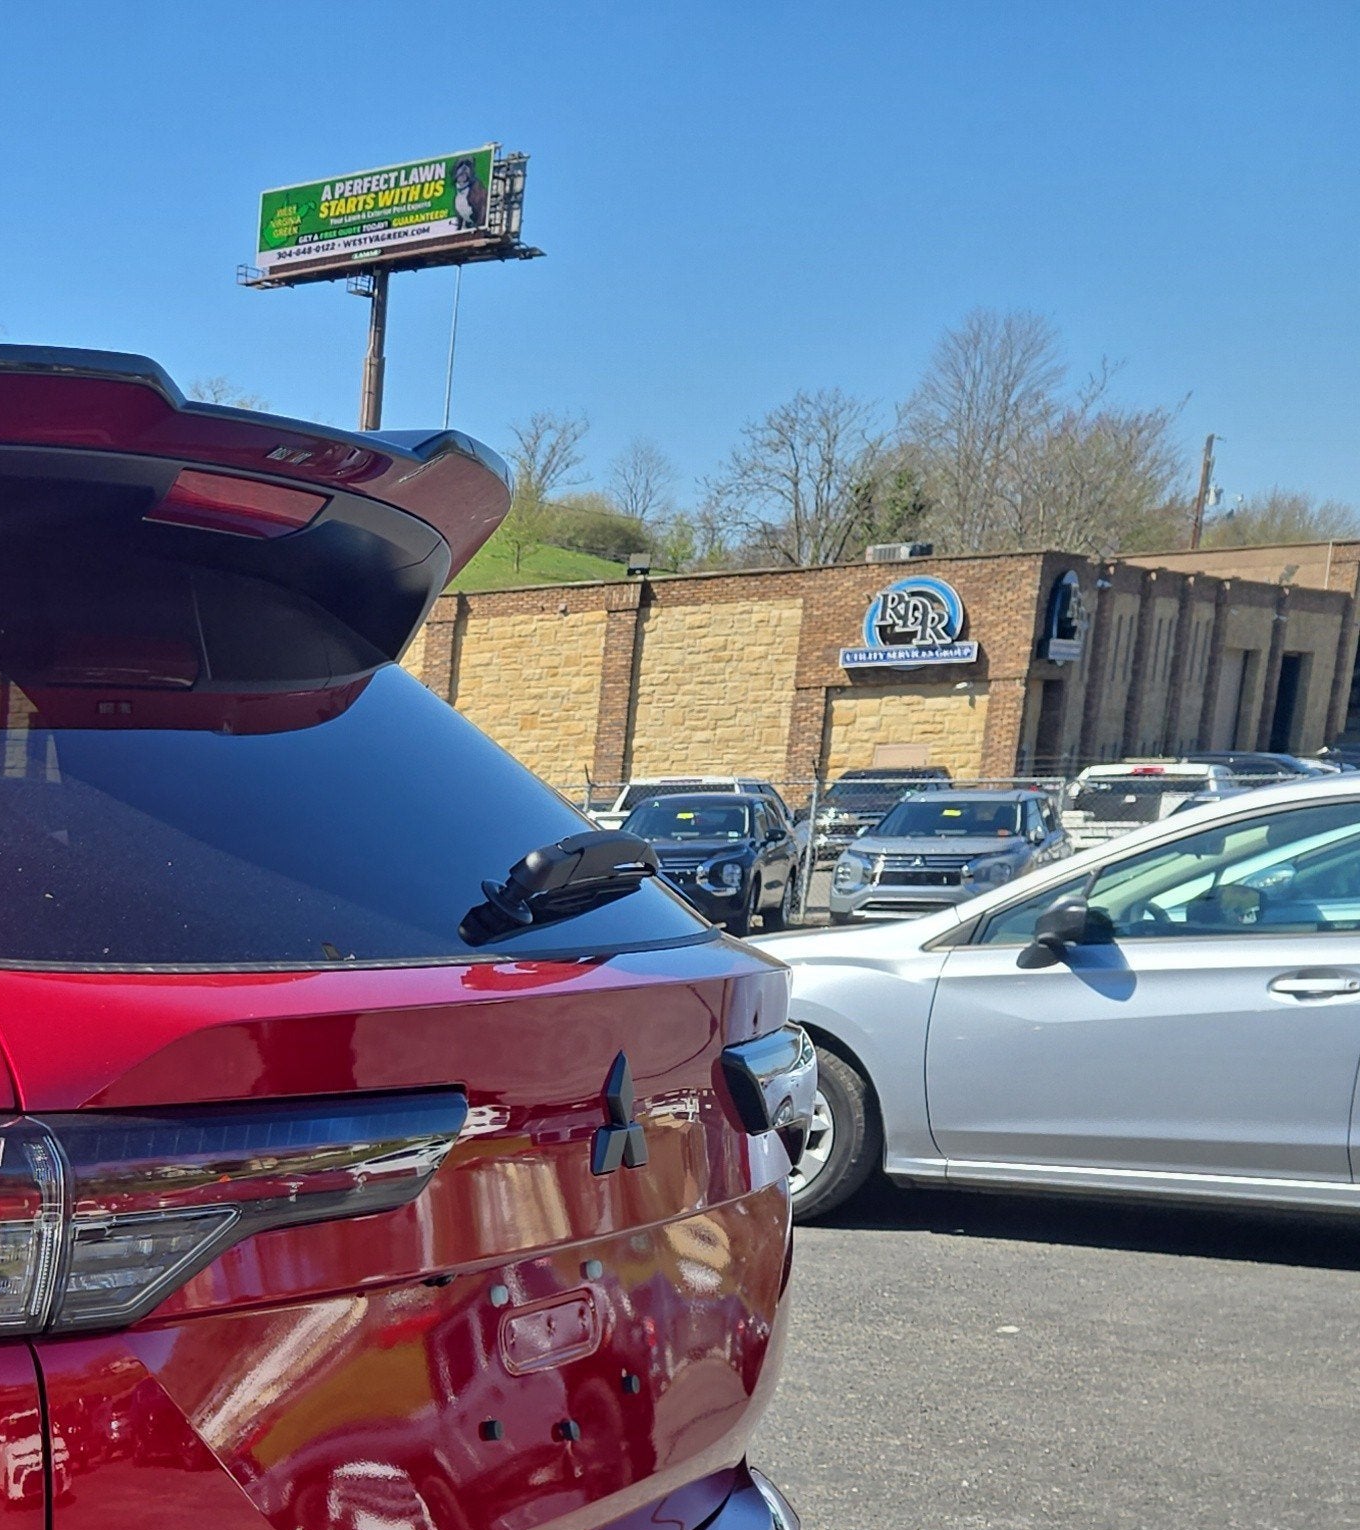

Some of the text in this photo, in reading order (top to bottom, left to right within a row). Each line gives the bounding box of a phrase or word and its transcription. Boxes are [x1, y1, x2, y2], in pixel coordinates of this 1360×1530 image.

[319, 180, 445, 219] STARTS WITH US
[321, 162, 446, 201] A PERFECT LAWN
[875, 590, 953, 645] RDR
